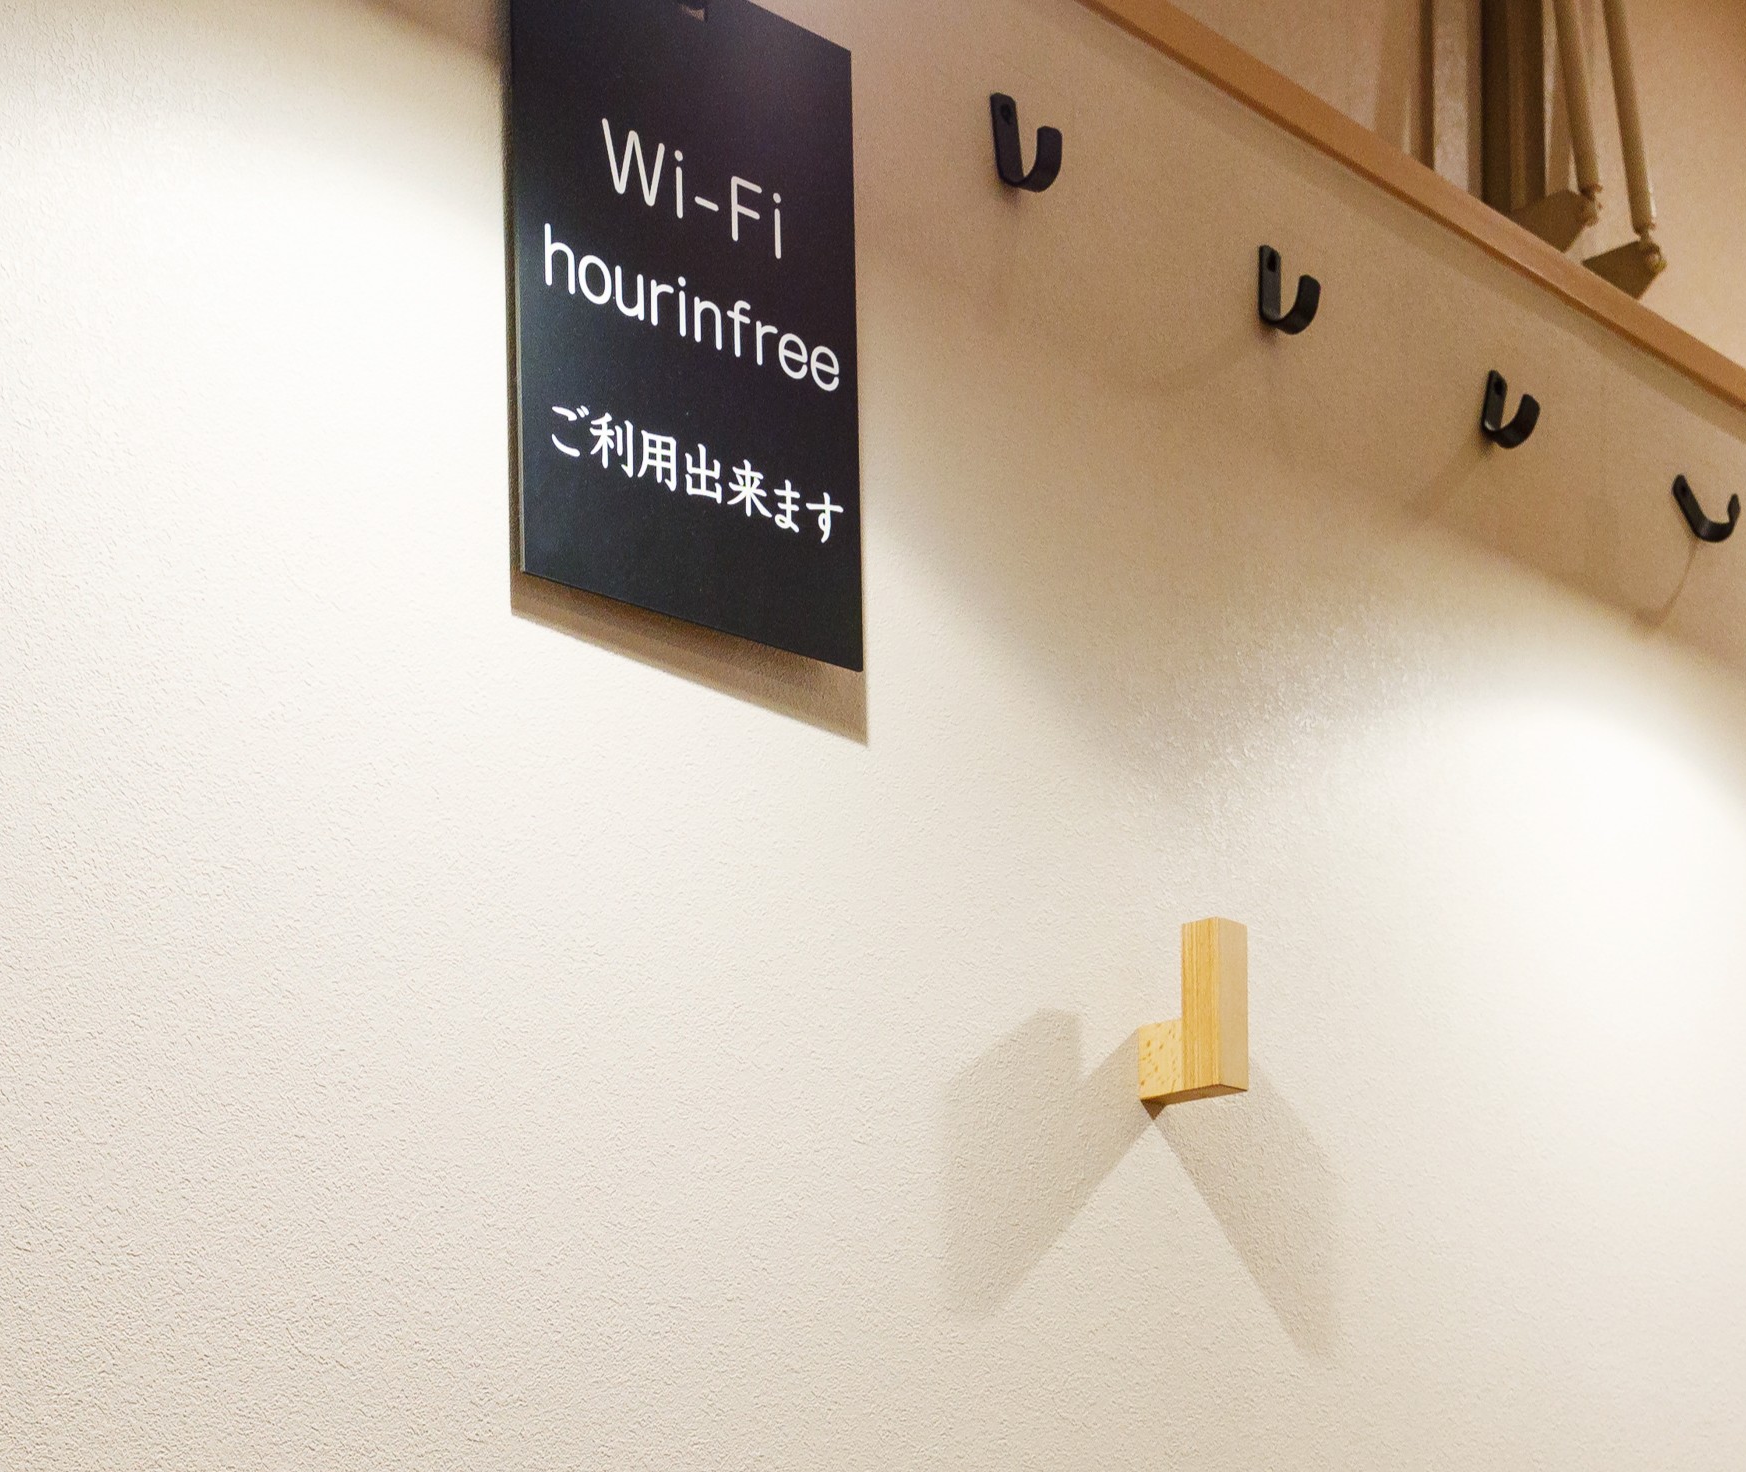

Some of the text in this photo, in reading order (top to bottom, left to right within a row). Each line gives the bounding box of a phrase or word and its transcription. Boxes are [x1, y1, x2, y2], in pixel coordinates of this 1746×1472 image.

[601, 117, 782, 259] Wi-Fi
[543, 222, 840, 392] hourinfree
[550, 403, 844, 543] ご利用出来ます
